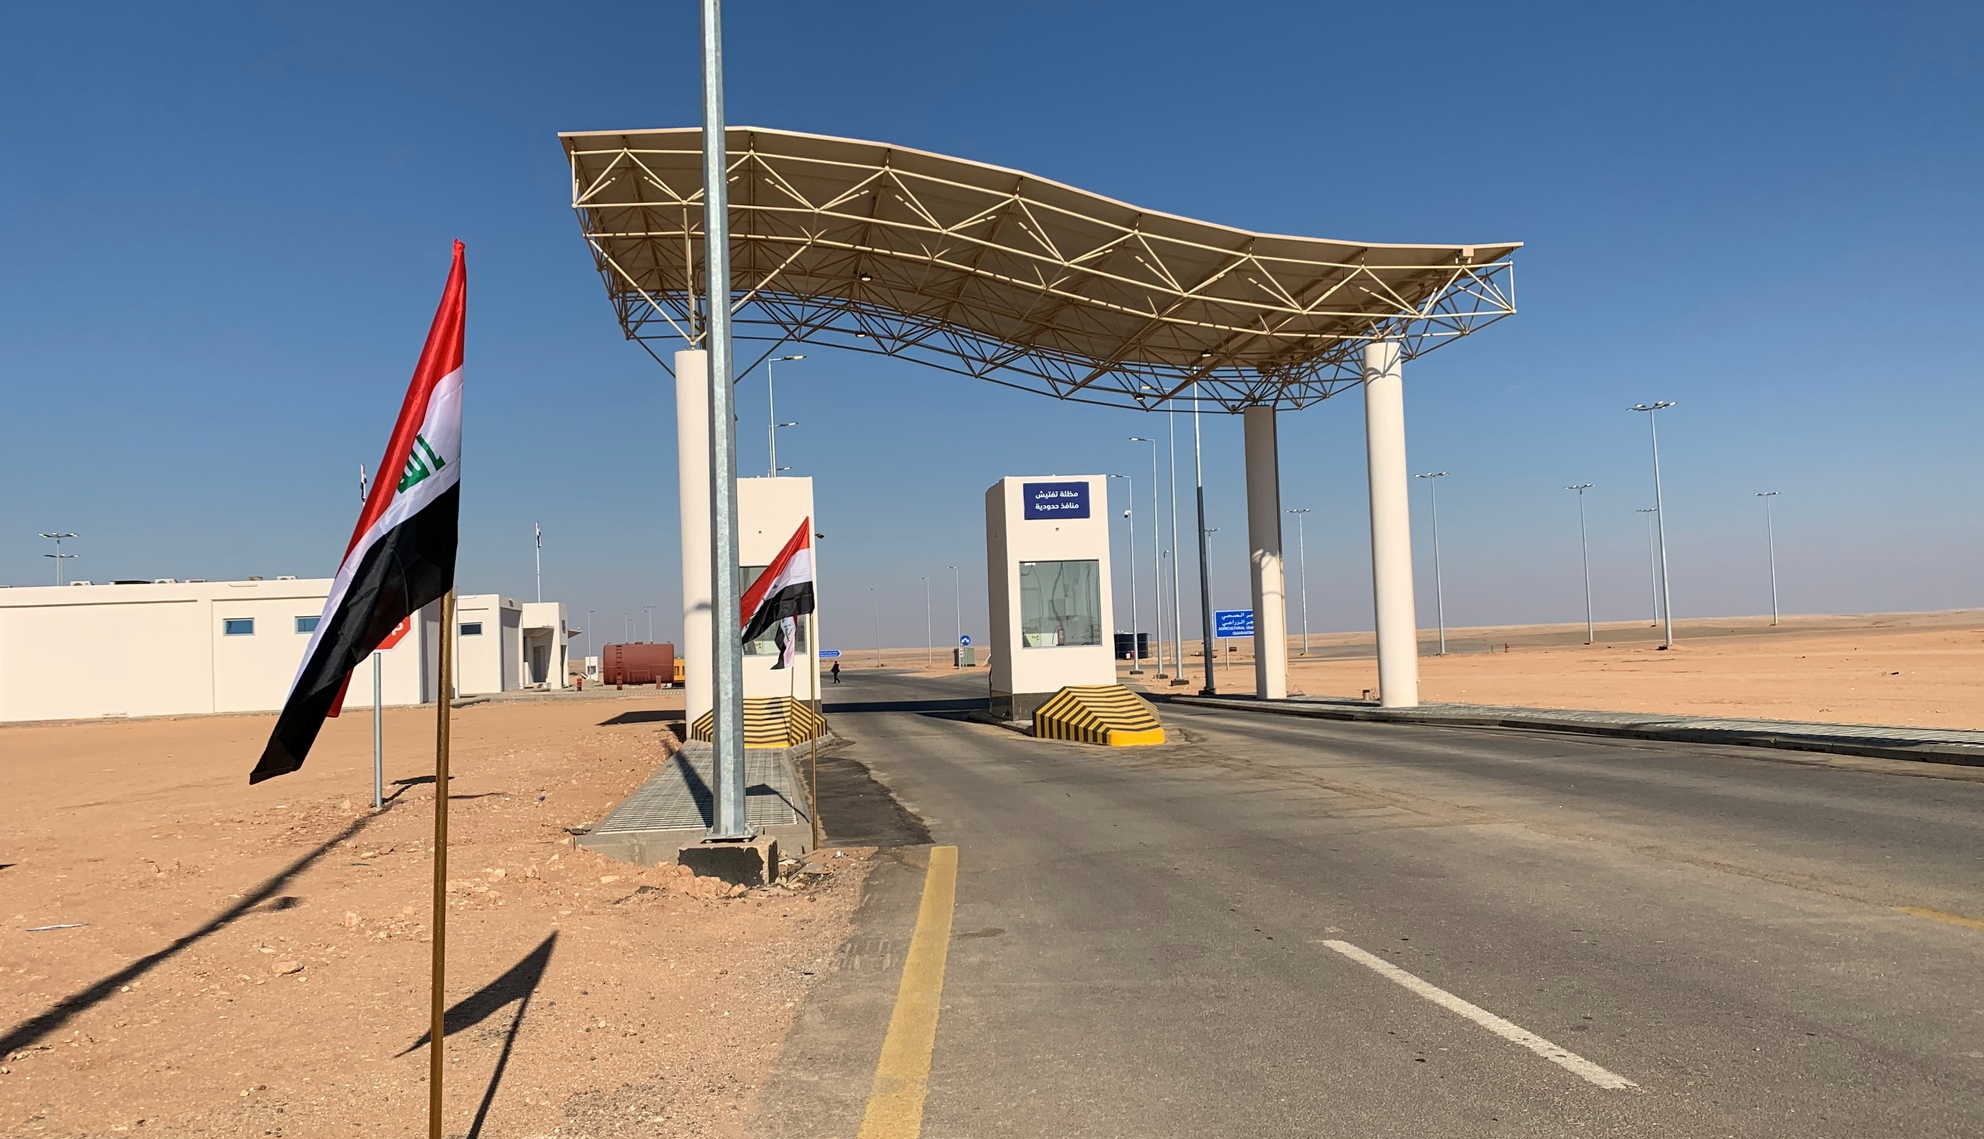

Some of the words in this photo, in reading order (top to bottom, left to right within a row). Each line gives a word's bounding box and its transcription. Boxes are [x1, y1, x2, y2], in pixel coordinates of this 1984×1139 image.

[1035, 490, 1059, 500] تفتيش
[1060, 490, 1079, 498] مظلة
[1035, 503, 1060, 512] حدودية
[1061, 502, 1080, 510] منافذ
